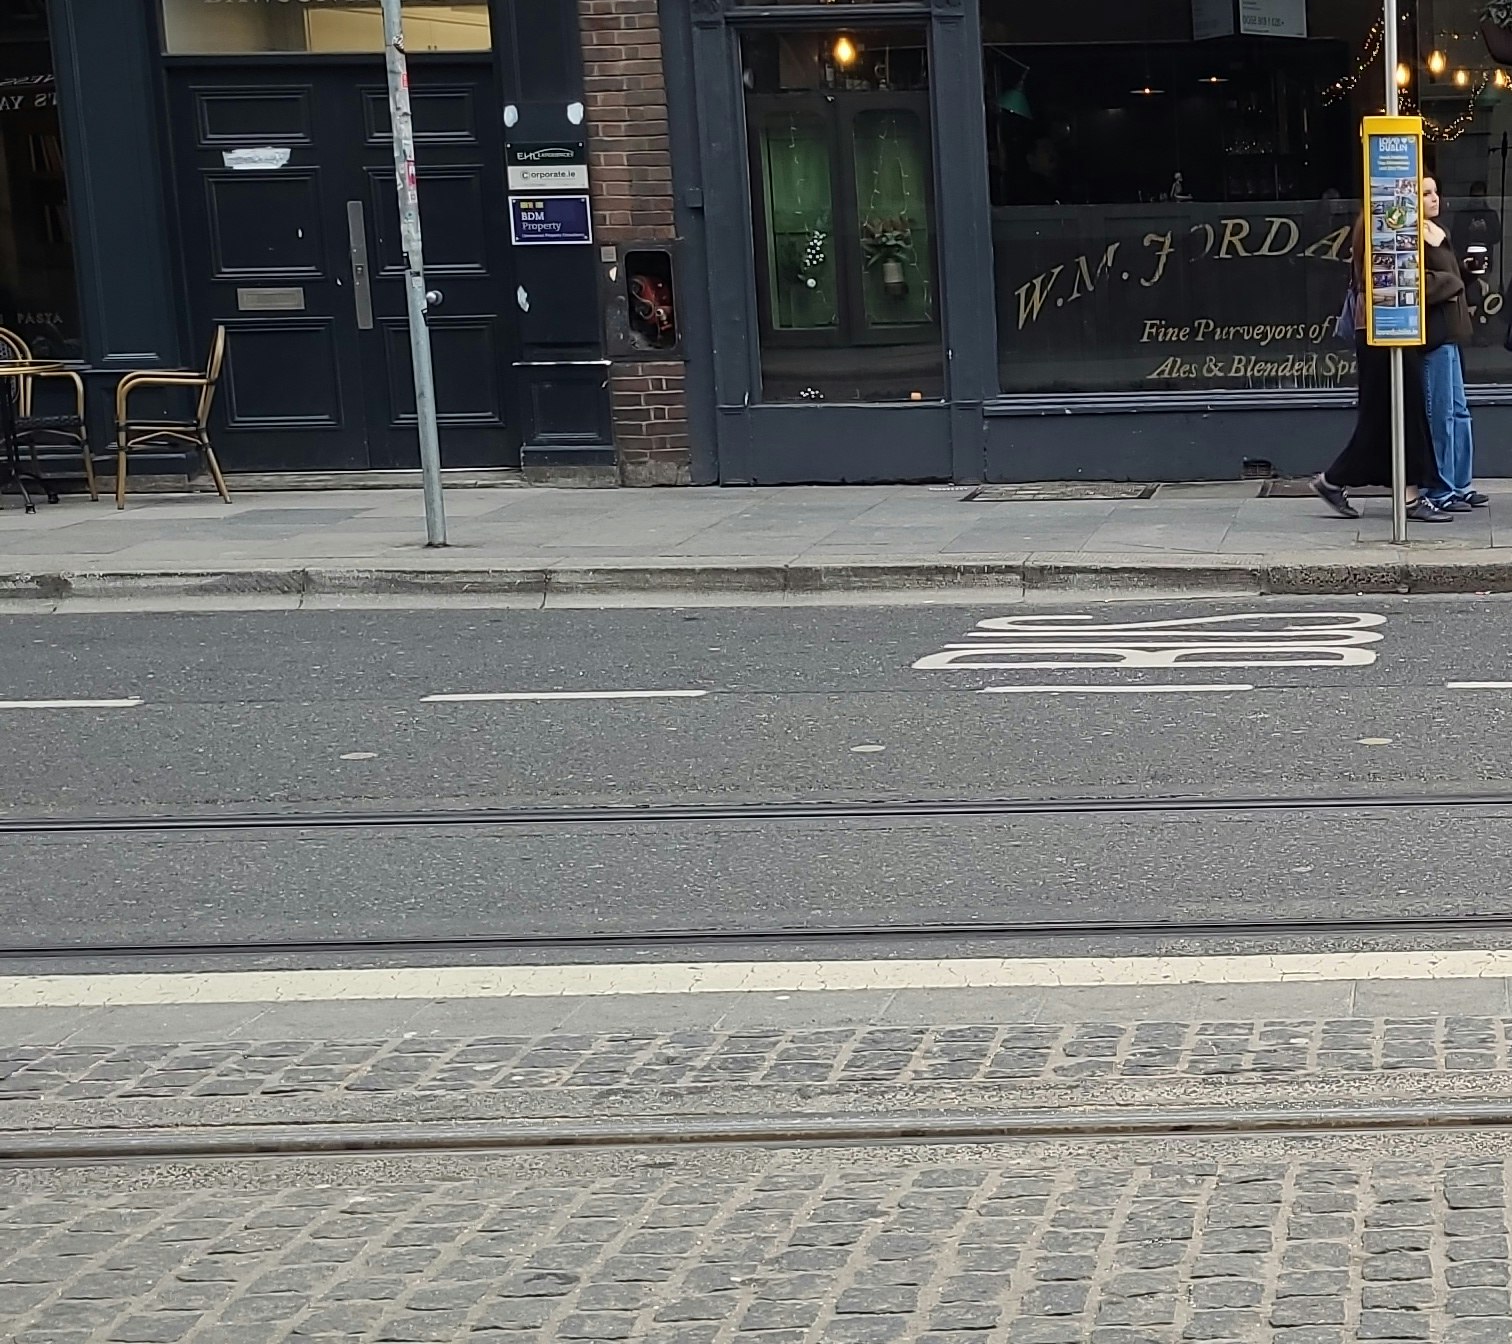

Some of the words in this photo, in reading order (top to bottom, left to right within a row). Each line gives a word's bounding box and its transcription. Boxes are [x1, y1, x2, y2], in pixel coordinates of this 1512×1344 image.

[521, 212, 545, 221] BDM
[522, 222, 562, 232] Property
[1139, 319, 1189, 343] Fine
[1194, 319, 1305, 349] Purveyors
[1308, 316, 1331, 344] of
[1146, 356, 1198, 379] Ales
[1202, 356, 1225, 377] &
[1231, 355, 1317, 378] Blended
[1324, 353, 1357, 378] Spi
[911, 612, 1388, 670] BUS
